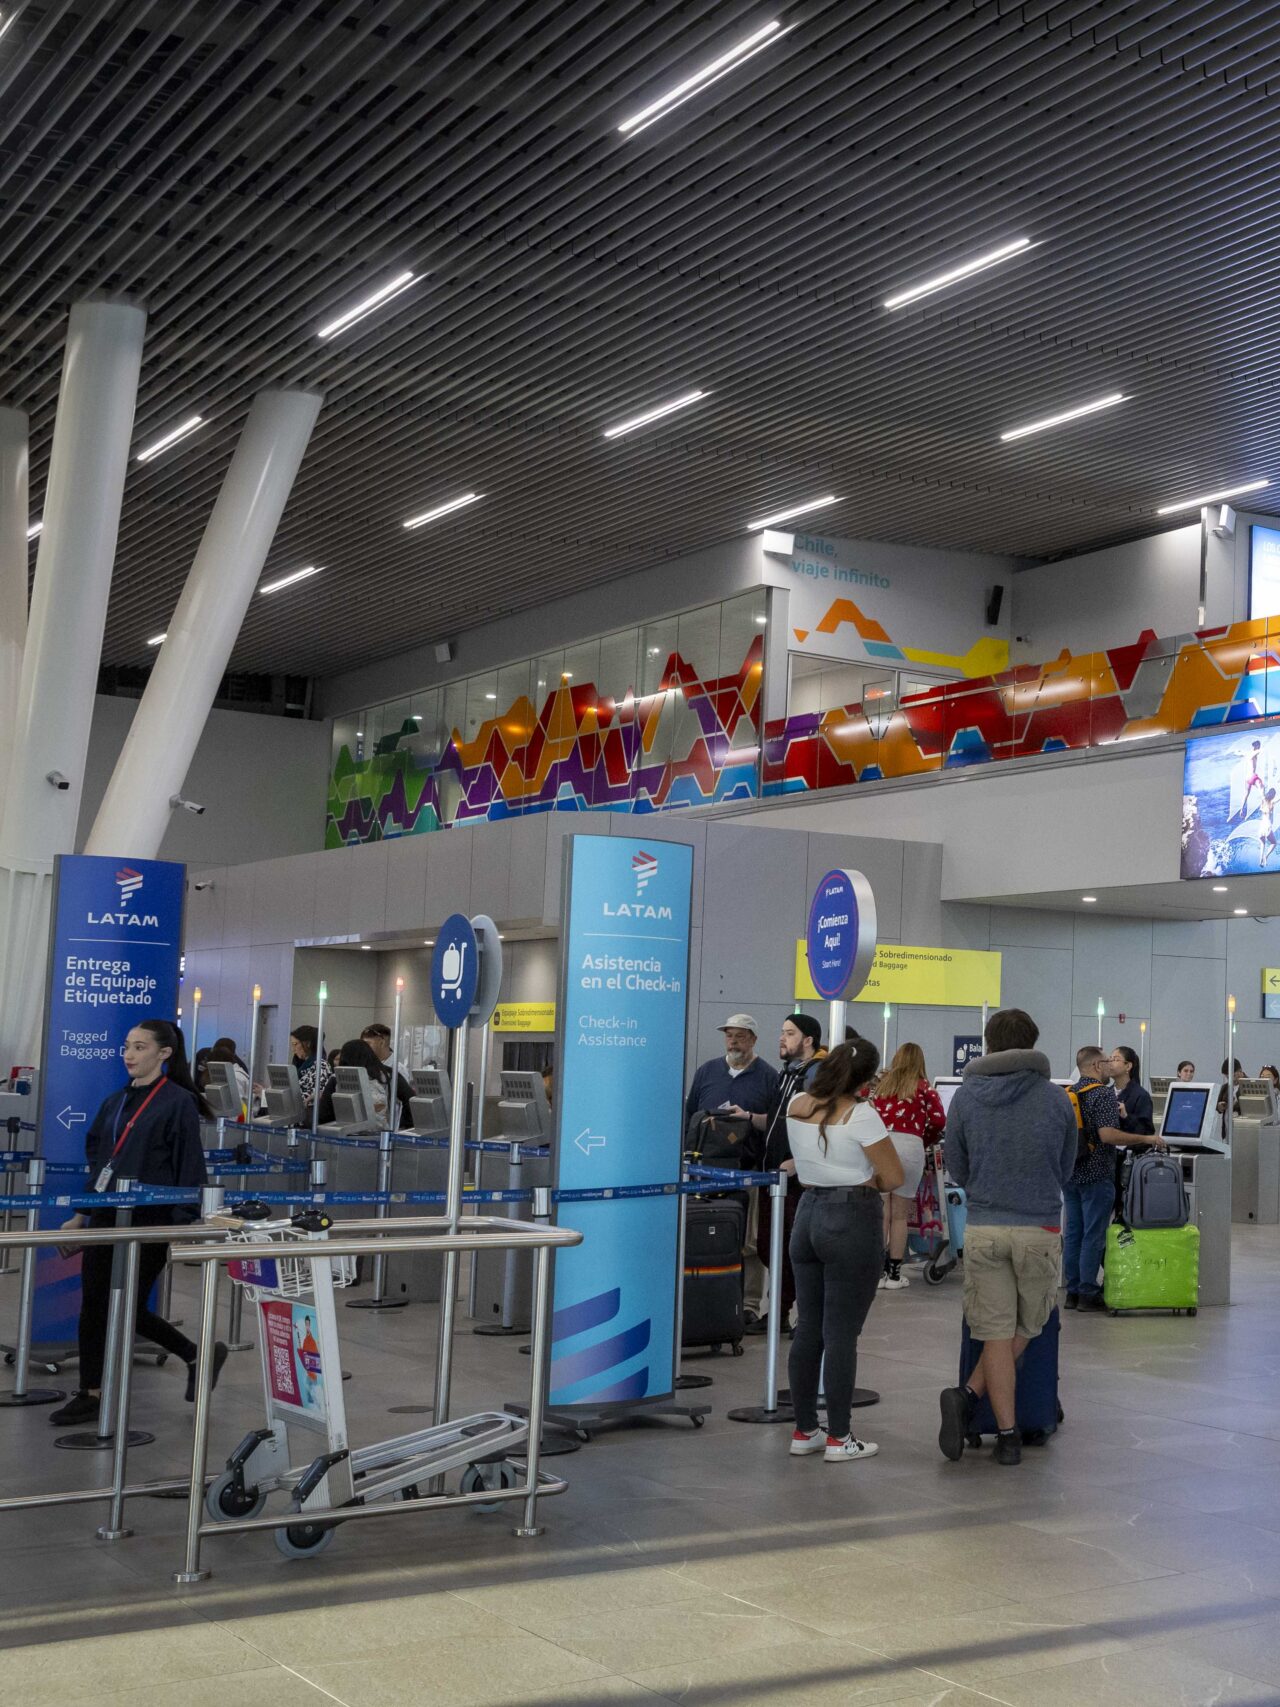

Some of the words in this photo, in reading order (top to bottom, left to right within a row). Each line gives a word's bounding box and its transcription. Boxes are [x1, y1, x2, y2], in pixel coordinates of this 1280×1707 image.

[794, 534, 838, 558] Chile,
[791, 560, 829, 579] viaje
[834, 565, 891, 589] infinito
[828, 886, 844, 896] LATAM
[603, 902, 673, 920] LATAM
[87, 912, 159, 928] LATAM
[817, 913, 849, 934] ¡Comienza
[581, 953, 662, 973] Asistencia
[879, 950, 953, 962] Sobredimensionado
[66, 956, 131, 975] Entrega
[878, 961, 908, 970] Baggage
[65, 972, 86, 987] de
[90, 973, 157, 993] Equipaje
[581, 975, 602, 989] en
[606, 973, 621, 990] el
[625, 974, 681, 993] Check-in
[64, 988, 152, 1007] Etiquetado
[578, 1015, 638, 1030] Check-in
[62, 1030, 108, 1044] Tagged
[577, 1033, 647, 1047] Assistance
[60, 1045, 116, 1060] Baggage
[969, 1043, 983, 1053] Bala
